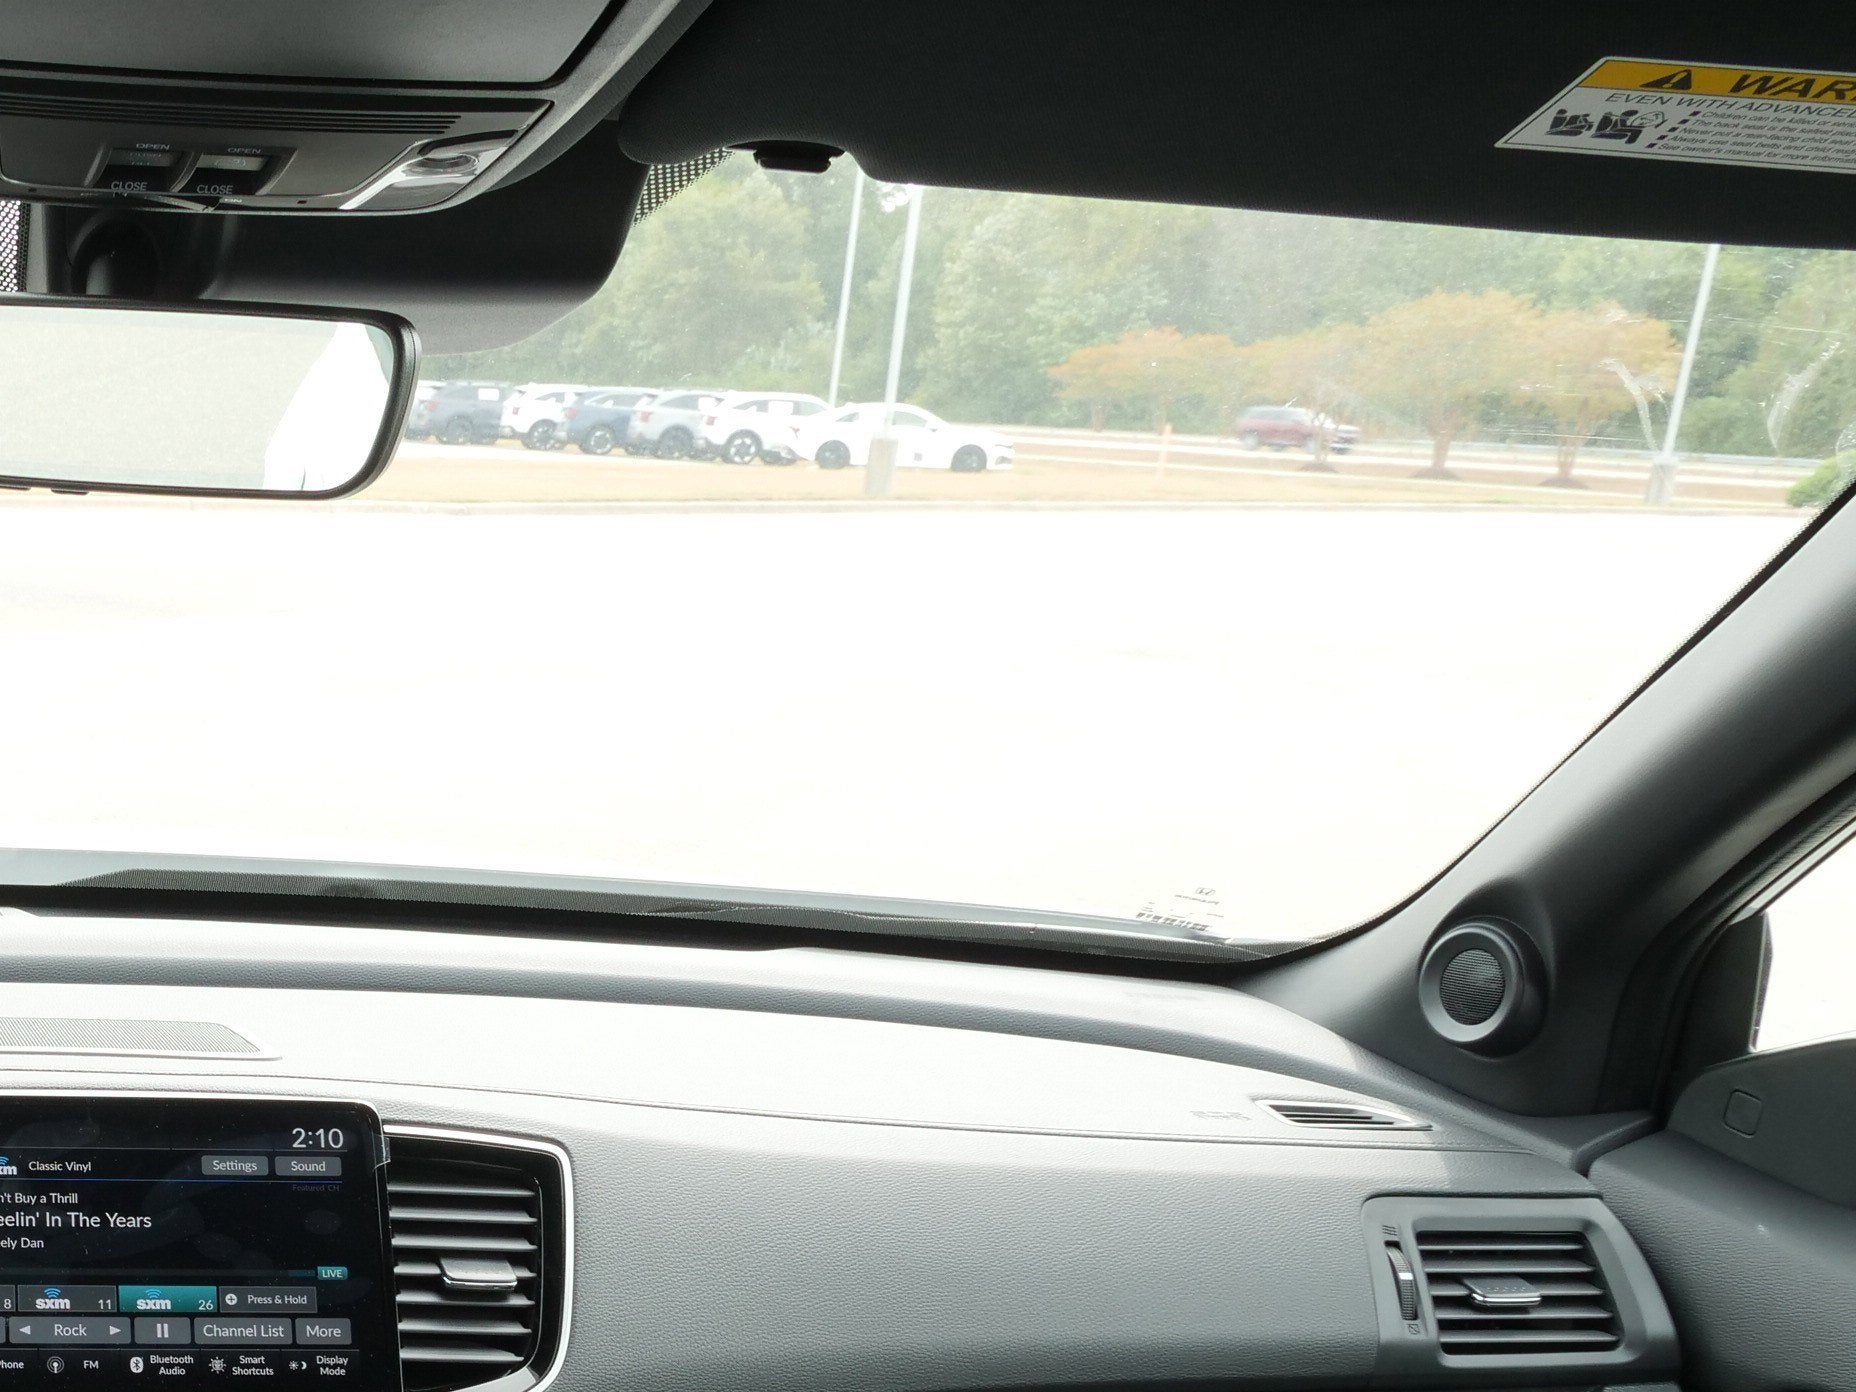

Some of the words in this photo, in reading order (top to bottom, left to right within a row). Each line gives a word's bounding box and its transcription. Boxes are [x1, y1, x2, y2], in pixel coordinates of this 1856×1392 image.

[1728, 74, 1856, 100] WAR
[1605, 93, 1673, 105] EVEN
[1676, 97, 1741, 109] WITH
[111, 182, 148, 191] CLOSE
[196, 185, 233, 194] CLOSE
[292, 1128, 344, 1148] 2:10
[28, 1162, 63, 1171] Classic
[66, 1161, 92, 1172] Vinyl
[212, 1160, 258, 1172] Settings
[291, 1161, 326, 1172] Sound
[14, 1193, 37, 1205] Buy
[49, 1193, 78, 1204] Thrill
[46, 1212, 62, 1227] In
[67, 1213, 101, 1228] The
[106, 1212, 152, 1229] Years
[21, 1238, 44, 1248] Dan
[322, 1269, 343, 1278] LIVE
[3, 1299, 12, 1310] 8
[35, 1298, 71, 1309] sxm
[98, 1300, 112, 1310] 11
[137, 1298, 172, 1310] sxm
[198, 1300, 214, 1310] 26
[248, 1295, 273, 1304] Press
[275, 1295, 283, 1304] &
[284, 1295, 307, 1304] Hold
[54, 1324, 87, 1336] Rock
[203, 1325, 257, 1337] Channel
[261, 1325, 284, 1337] List
[306, 1325, 342, 1338] More
[83, 1360, 99, 1369] FM
[150, 1355, 194, 1364] Bluetooth
[239, 1356, 265, 1364] Smart
[316, 1356, 349, 1366] Display
[159, 1367, 186, 1376] Audio
[232, 1367, 274, 1376] Shortcuts
[320, 1367, 346, 1376] Mode
